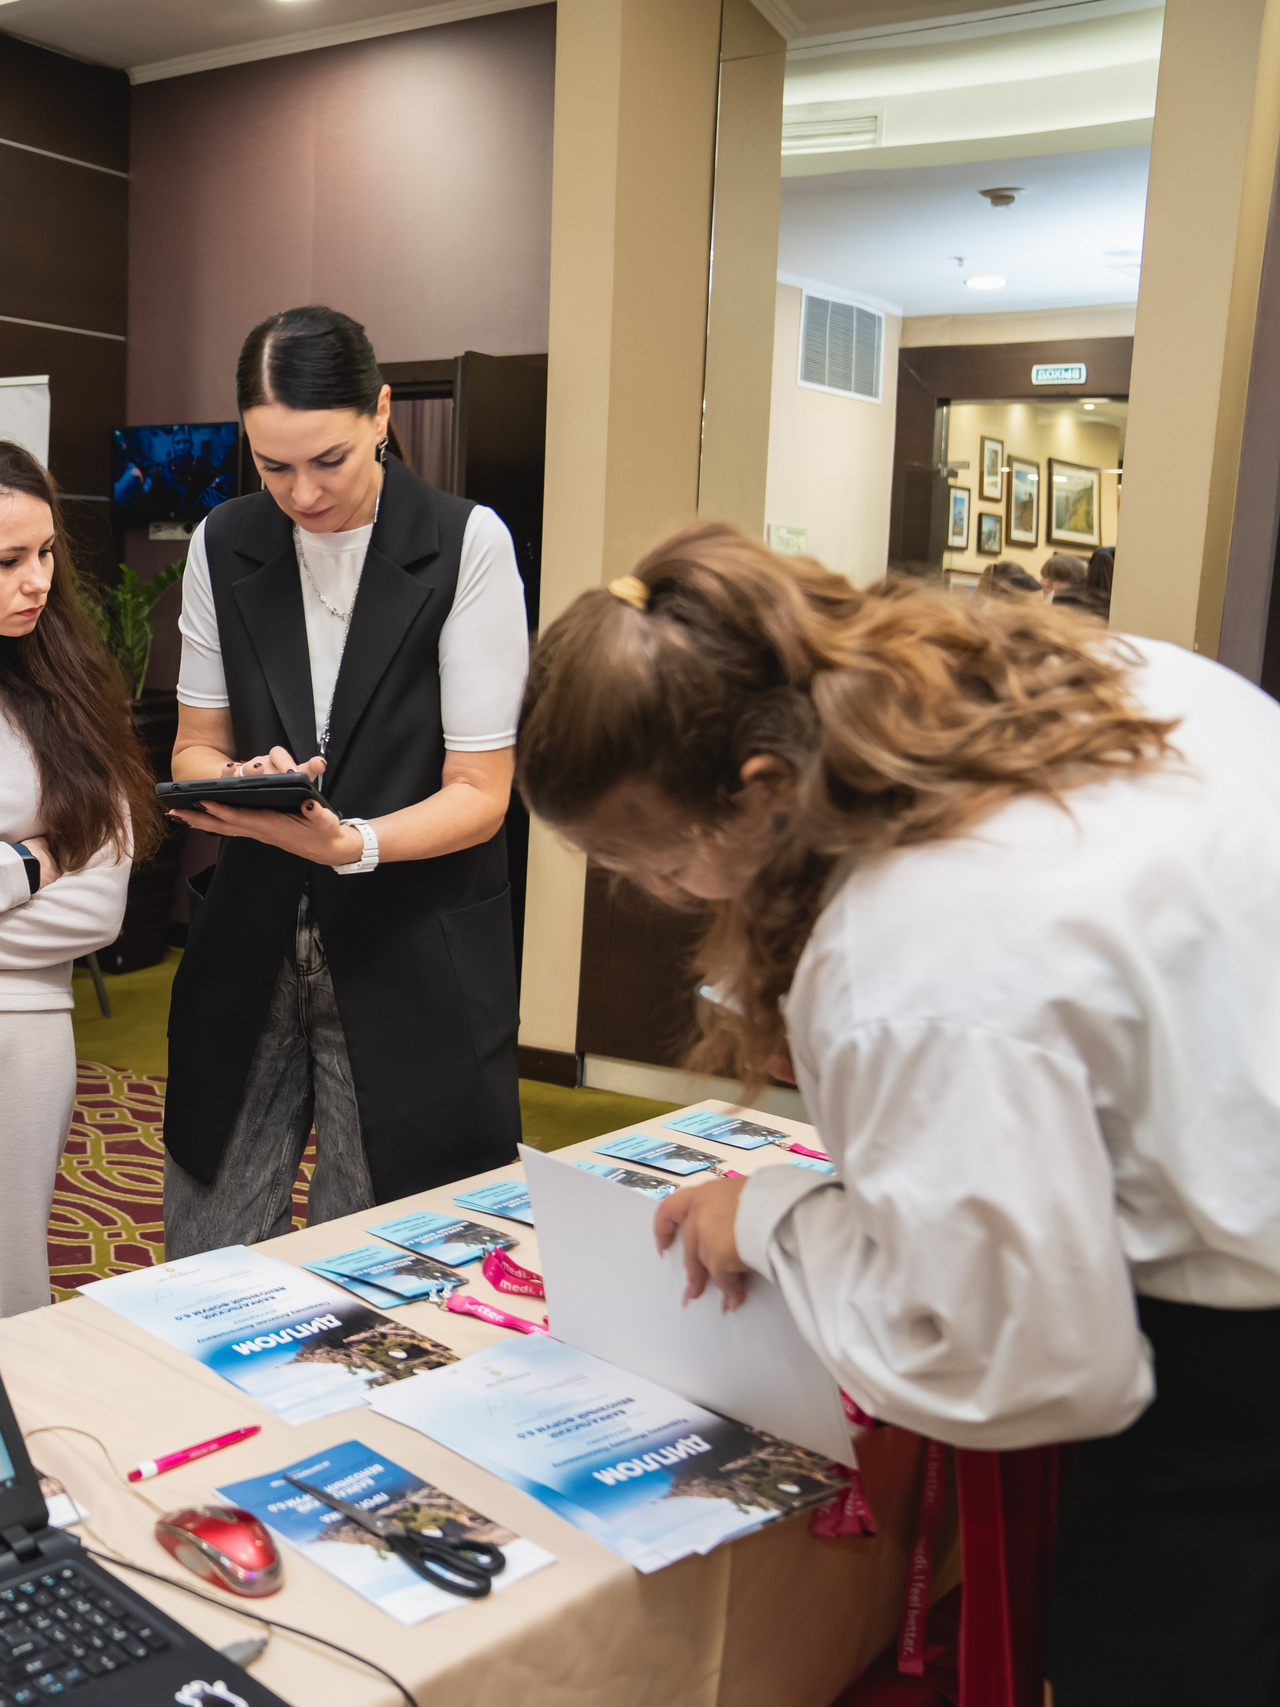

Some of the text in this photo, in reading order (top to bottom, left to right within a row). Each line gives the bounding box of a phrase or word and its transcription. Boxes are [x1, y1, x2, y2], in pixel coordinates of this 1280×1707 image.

[231, 1313, 343, 1356] ДИПЛОМ
[591, 1433, 713, 1486] ДИПЛОМ
[294, 1476, 376, 1515] БАЙКАКИЙ
[318, 1491, 391, 1524] ПРОГМА
